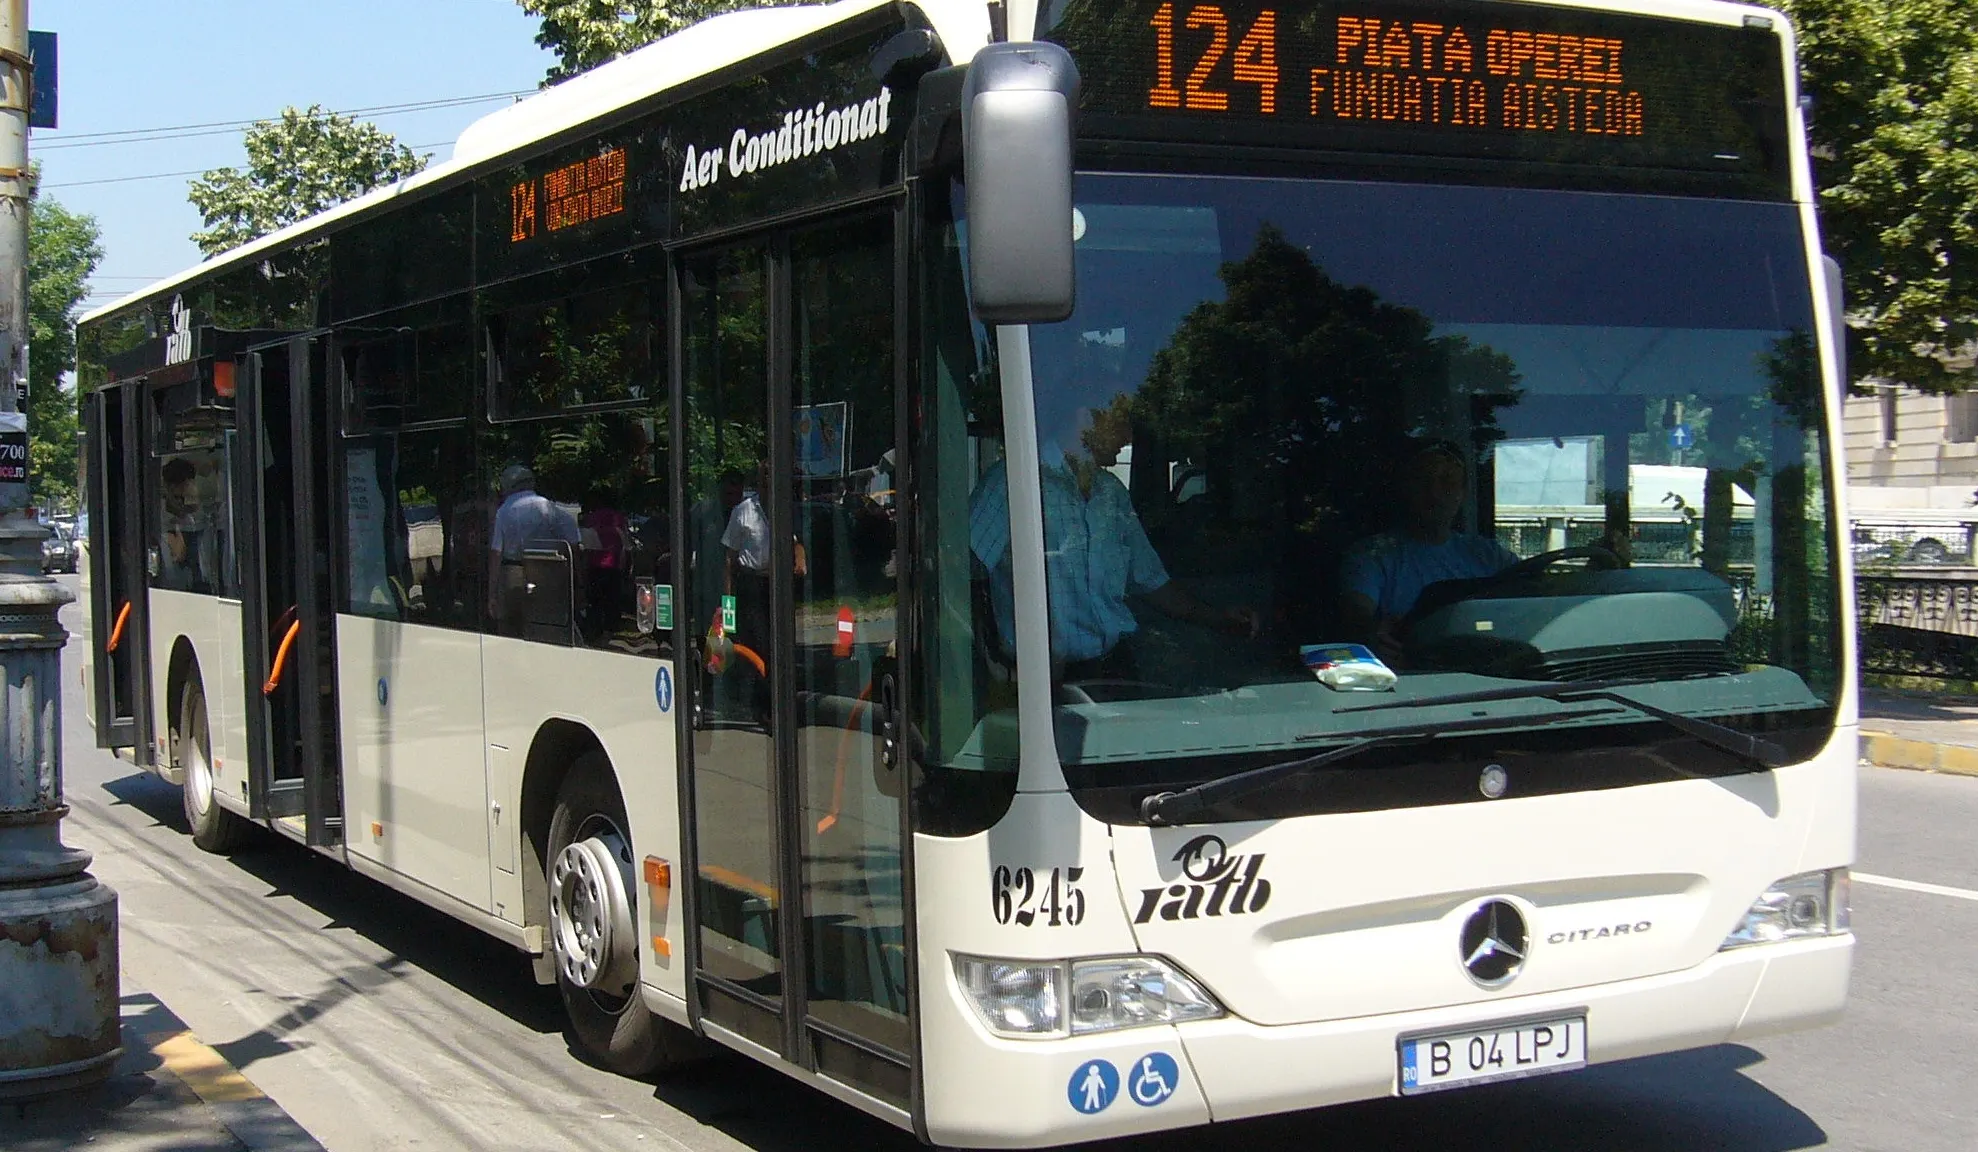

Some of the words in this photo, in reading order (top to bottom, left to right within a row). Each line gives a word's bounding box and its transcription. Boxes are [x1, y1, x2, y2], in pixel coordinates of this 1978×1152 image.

[1148, 2, 1279, 115] 124
[1336, 16, 1473, 73] PIATA
[1486, 29, 1624, 85] OPEREI
[1310, 68, 1488, 127] FUNDATIA
[1503, 81, 1644, 137] AISTEDA
[680, 144, 723, 193] Aer
[729, 85, 892, 178] Conditionat
[511, 180, 535, 242] 124
[992, 864, 1085, 927] 6245
[1547, 920, 1652, 945] CITARO
[1403, 1067, 1417, 1082] RO
[1430, 1041, 1452, 1077] B
[1469, 1033, 1504, 1071] 04
[1516, 1024, 1570, 1065] LPJ
